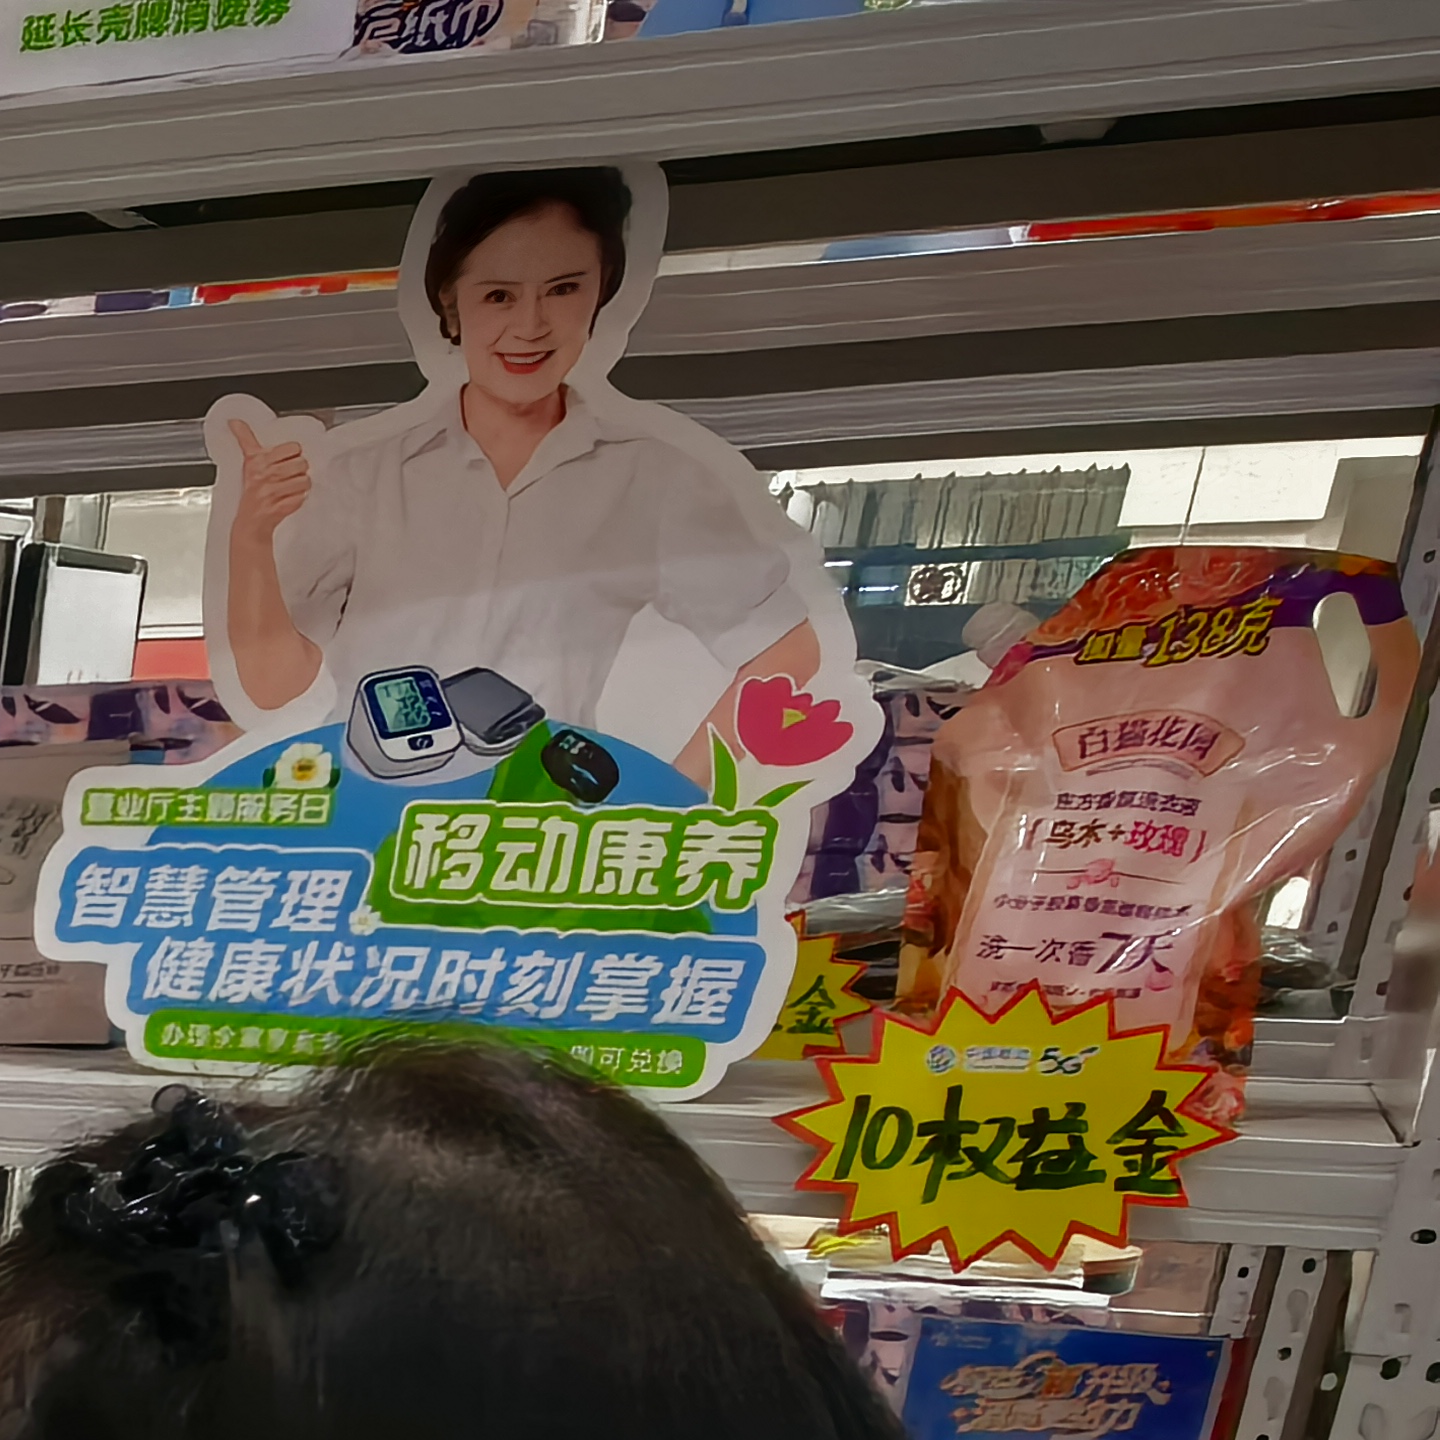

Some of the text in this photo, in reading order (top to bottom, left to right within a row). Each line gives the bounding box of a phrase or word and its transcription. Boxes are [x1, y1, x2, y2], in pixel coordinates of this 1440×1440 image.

[70, 863, 354, 934] 智慧管理
[404, 813, 770, 911] 移动康养
[142, 936, 748, 1025] 健康状况时刻掌握
[833, 1084, 1189, 1205] 10权益金
